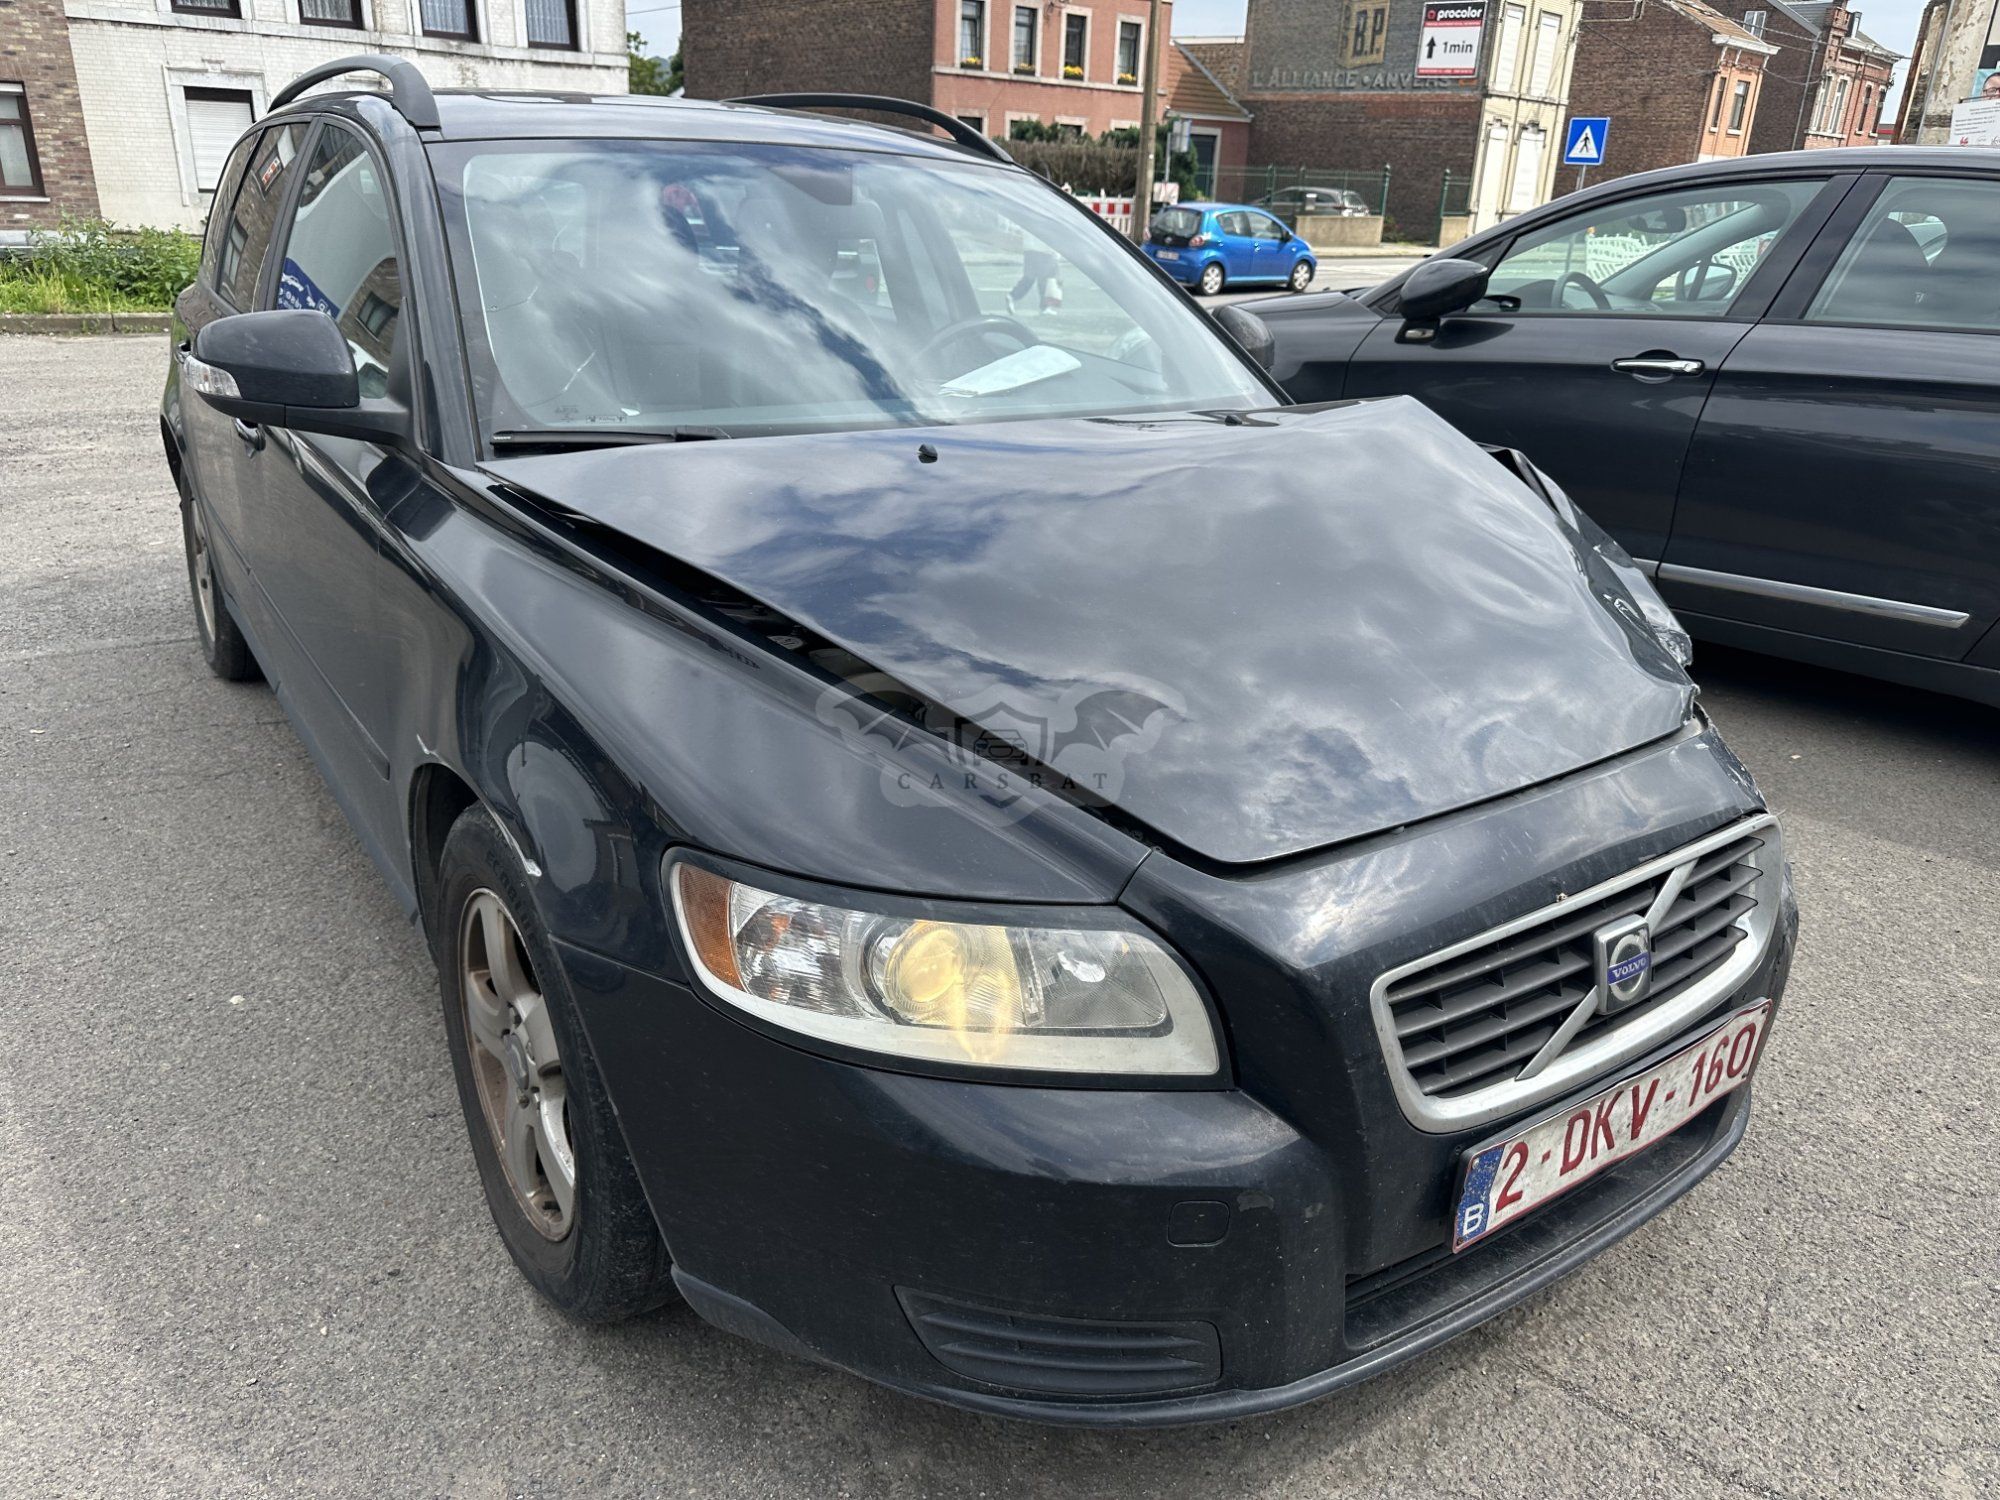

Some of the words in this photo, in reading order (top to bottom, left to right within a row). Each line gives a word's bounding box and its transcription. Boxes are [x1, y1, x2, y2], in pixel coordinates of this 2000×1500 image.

[1437, 6, 1482, 21] procolor
[1612, 957, 1647, 978] VOLVO
[1463, 1203, 1483, 1236] B
[1495, 1022, 1757, 1213] 2-DKV-160
